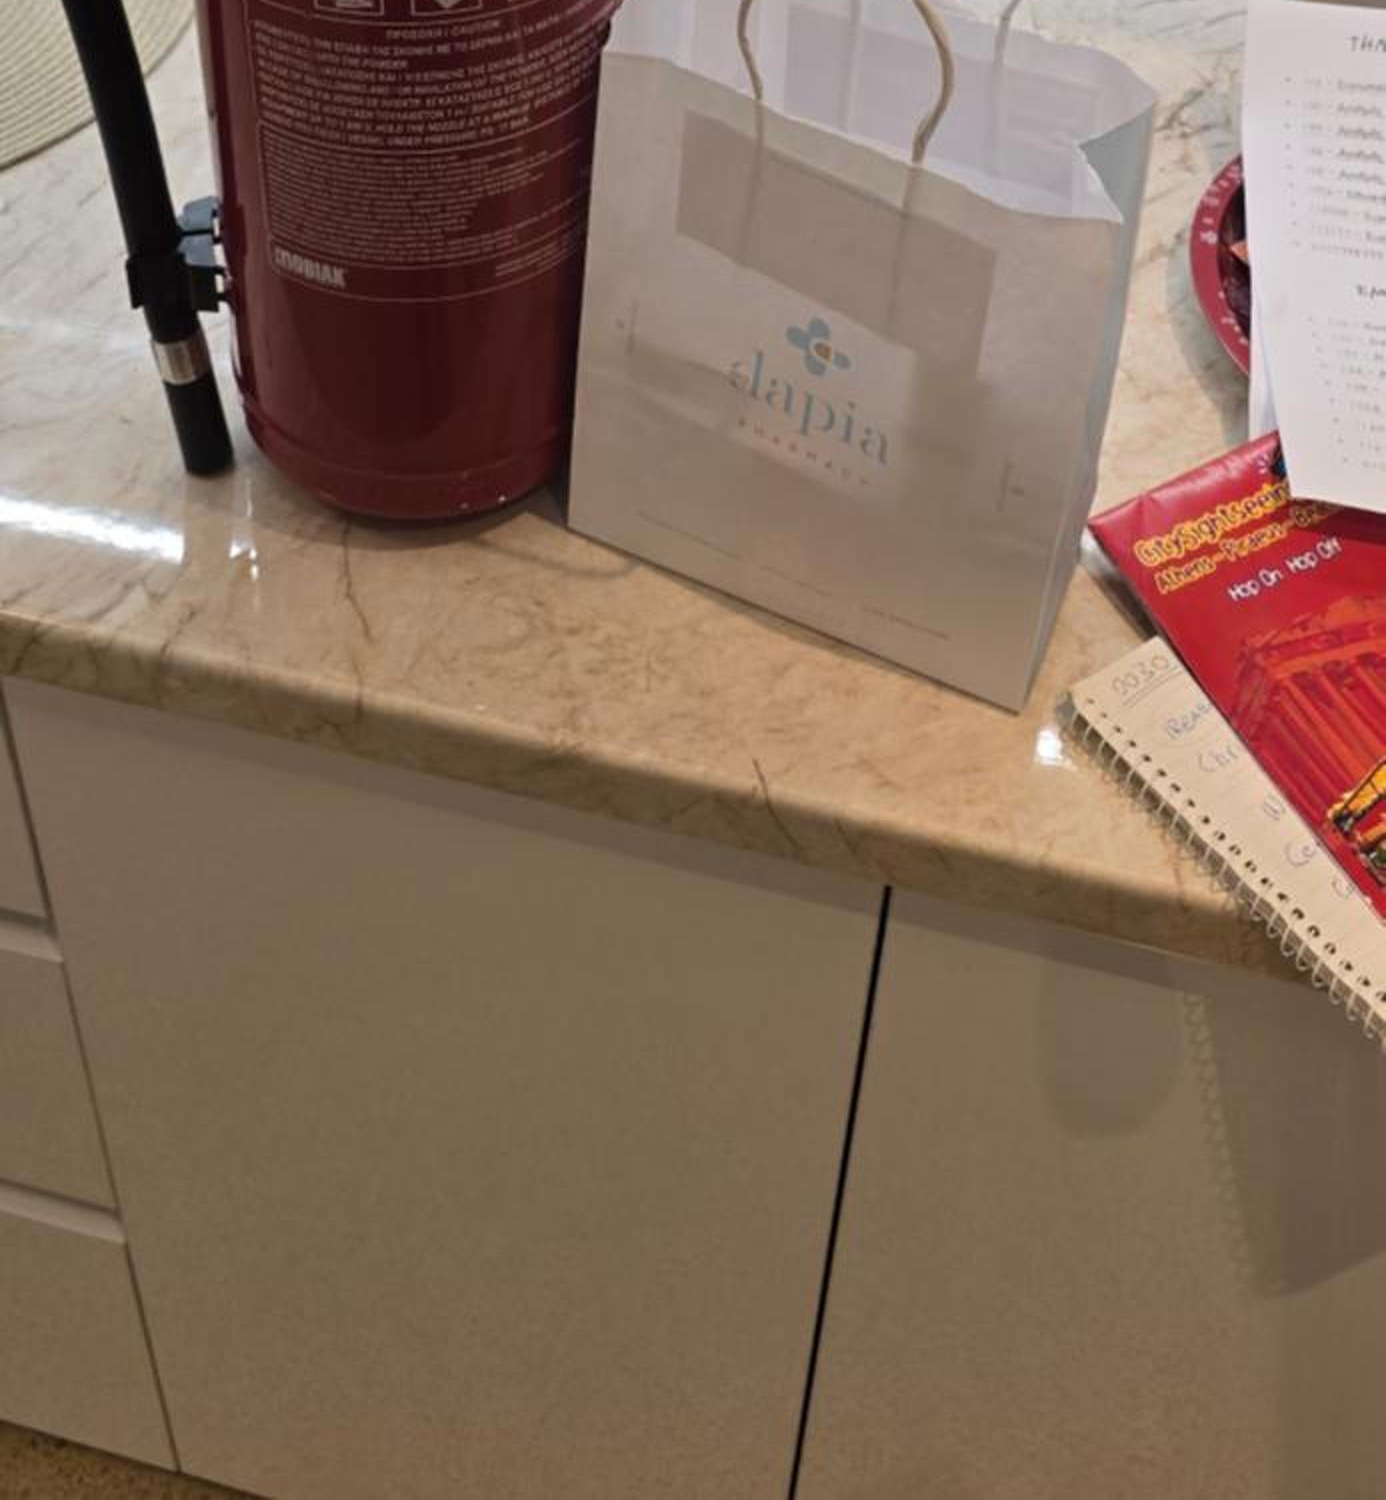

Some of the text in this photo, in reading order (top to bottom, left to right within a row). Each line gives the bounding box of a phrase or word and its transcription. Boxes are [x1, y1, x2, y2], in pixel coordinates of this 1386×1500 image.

[1227, 535, 1342, 600] Hop On Hop Off
